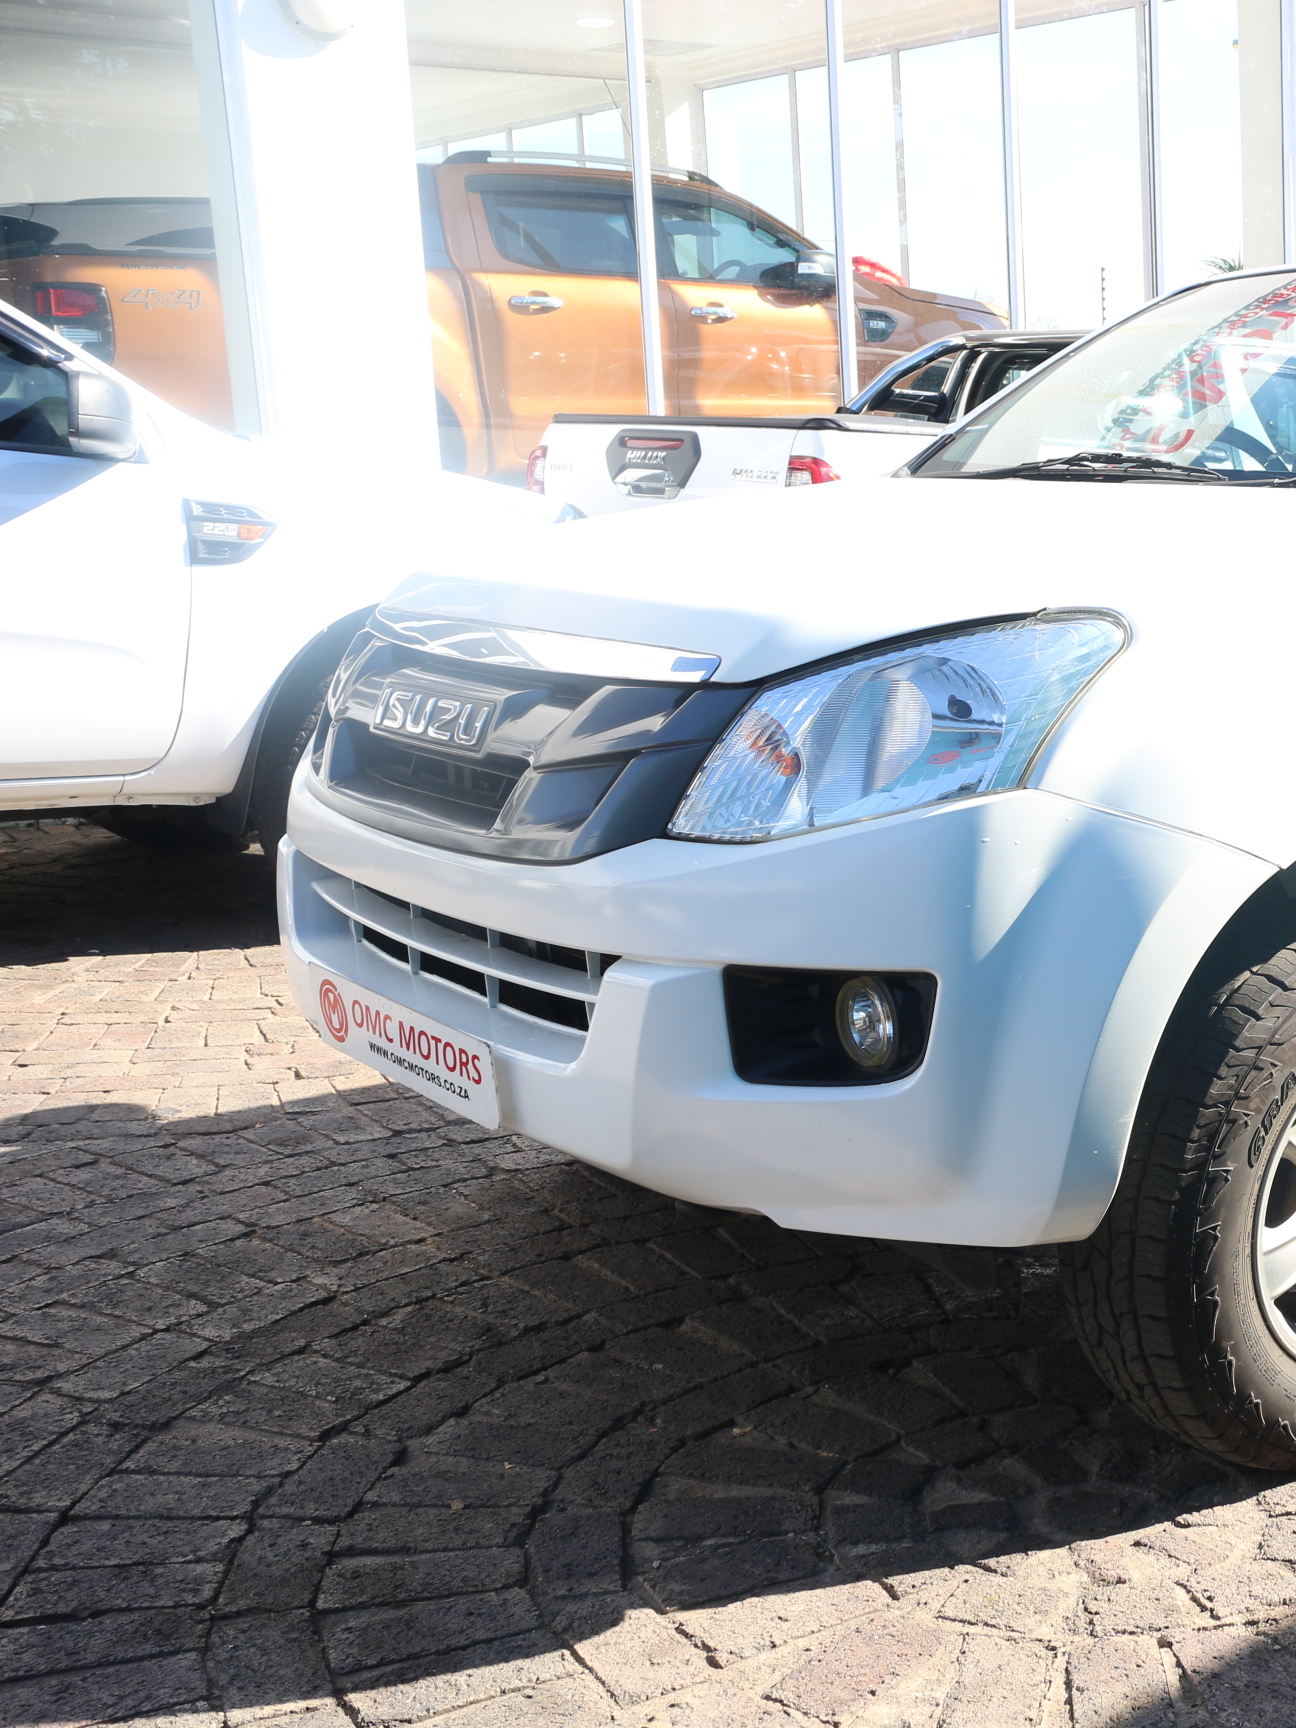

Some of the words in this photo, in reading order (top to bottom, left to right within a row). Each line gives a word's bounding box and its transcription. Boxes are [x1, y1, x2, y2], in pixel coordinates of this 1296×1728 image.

[626, 450, 667, 464] HILUX
[375, 688, 491, 746] ISUZU
[352, 999, 394, 1044] OMC
[398, 1020, 482, 1085] MOTORS
[368, 1040, 471, 1101] WWW.OMCMOTORS.CO.ZA
